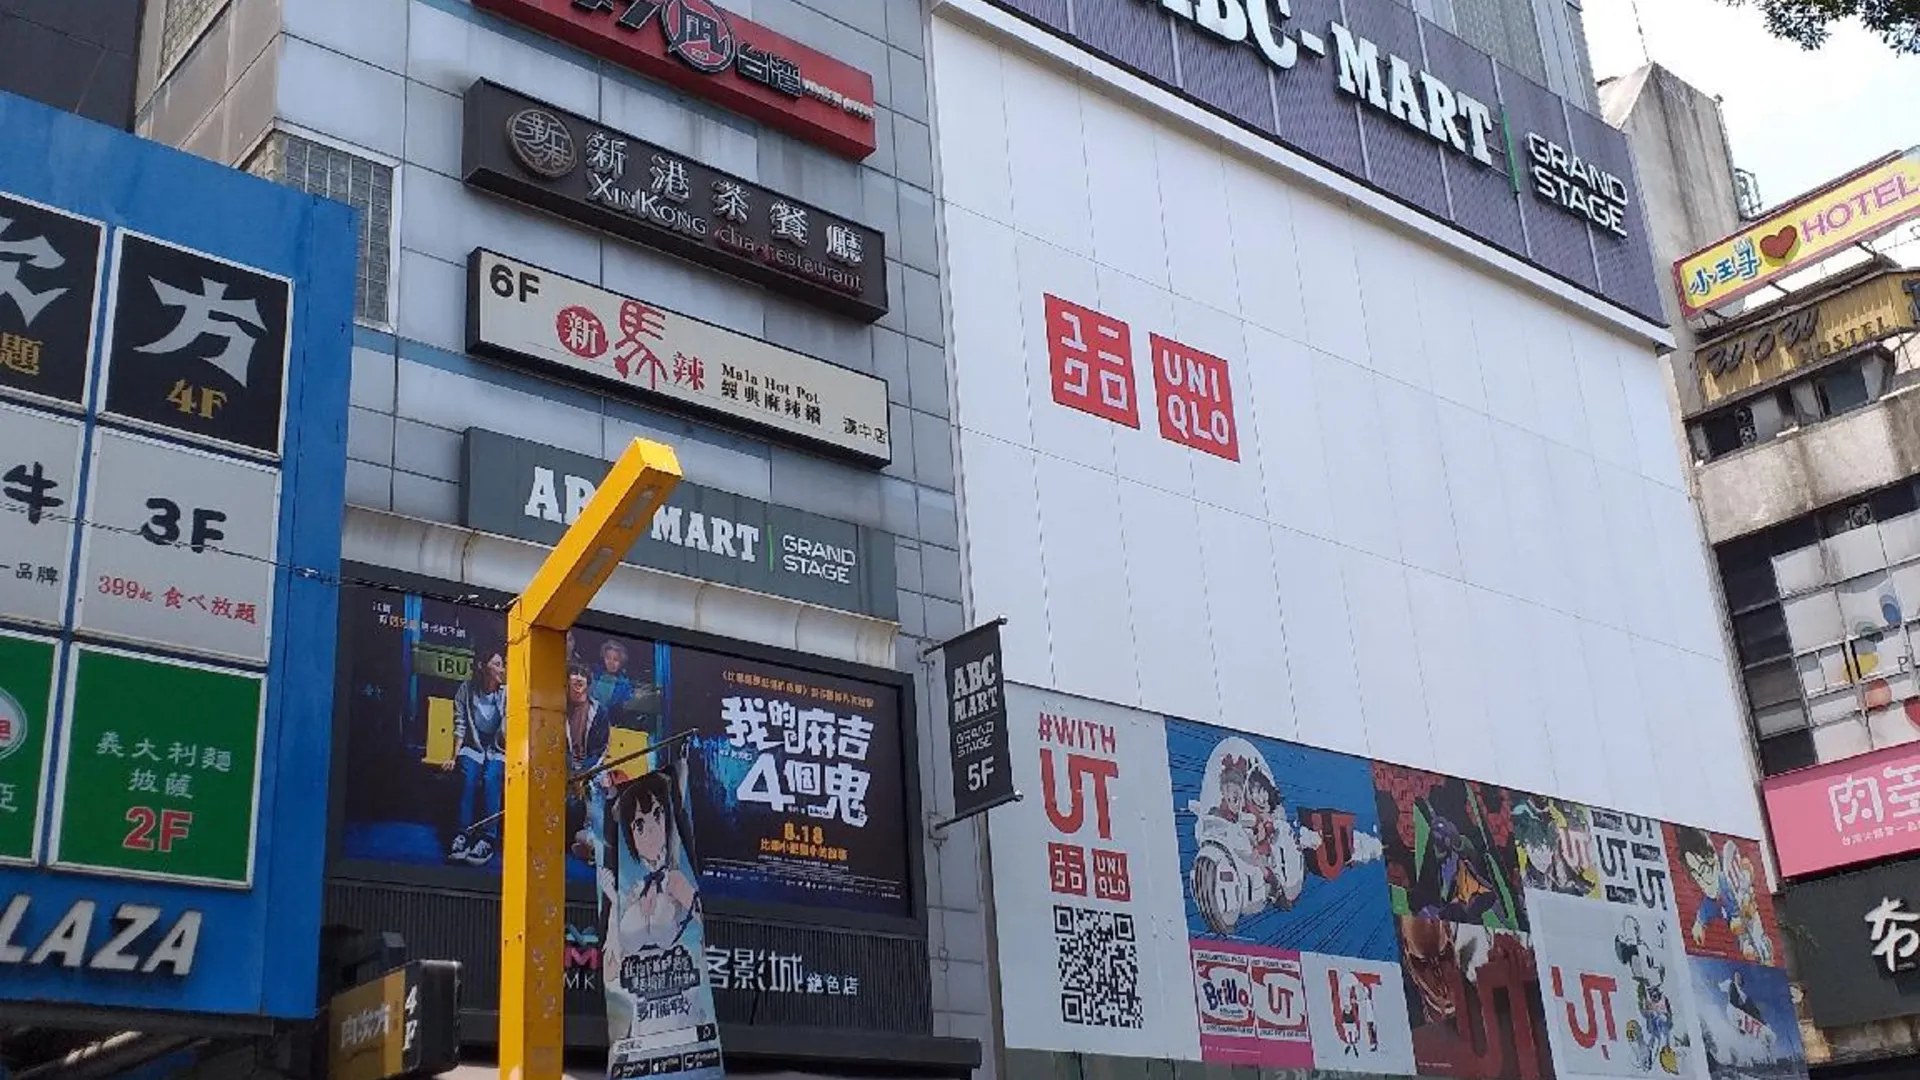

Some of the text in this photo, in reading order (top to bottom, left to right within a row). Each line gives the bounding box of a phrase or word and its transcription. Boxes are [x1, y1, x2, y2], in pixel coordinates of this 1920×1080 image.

[1526, 132, 1628, 206] GRAND
[585, 131, 864, 264] 新港茶餐廳
[1533, 164, 1628, 237] STAGE
[1801, 173, 1920, 243] HOTEL
[489, 264, 541, 303] 6F
[133, 275, 268, 388] 方
[721, 363, 821, 404] Mala Hot Pot
[1163, 349, 1221, 402] UNI
[166, 378, 228, 420] 4F
[1167, 394, 1229, 445] QLO
[2, 461, 64, 525] 牛
[141, 497, 227, 554] 3F
[782, 535, 856, 566] GRAND
[783, 554, 851, 584] STAGE
[162, 586, 257, 625] 食べ放題
[952, 653, 997, 700] ABC
[954, 686, 998, 723] MART
[721, 696, 874, 761] 我的麻吉
[956, 721, 995, 745] GRAND
[957, 734, 993, 758] STAGE
[1039, 711, 1116, 754] #WITH
[96, 731, 233, 772] 義大利麵
[967, 756, 994, 791] 5F
[128, 768, 194, 799] 披薩
[736, 752, 872, 828] 4個鬼
[1039, 748, 1119, 841] UT
[122, 805, 194, 853] 2F
[784, 822, 824, 844] 8.18
[1636, 866, 1668, 911] UT
[704, 944, 804, 993] 客影城
[1203, 977, 1295, 1019] Brillo UT
